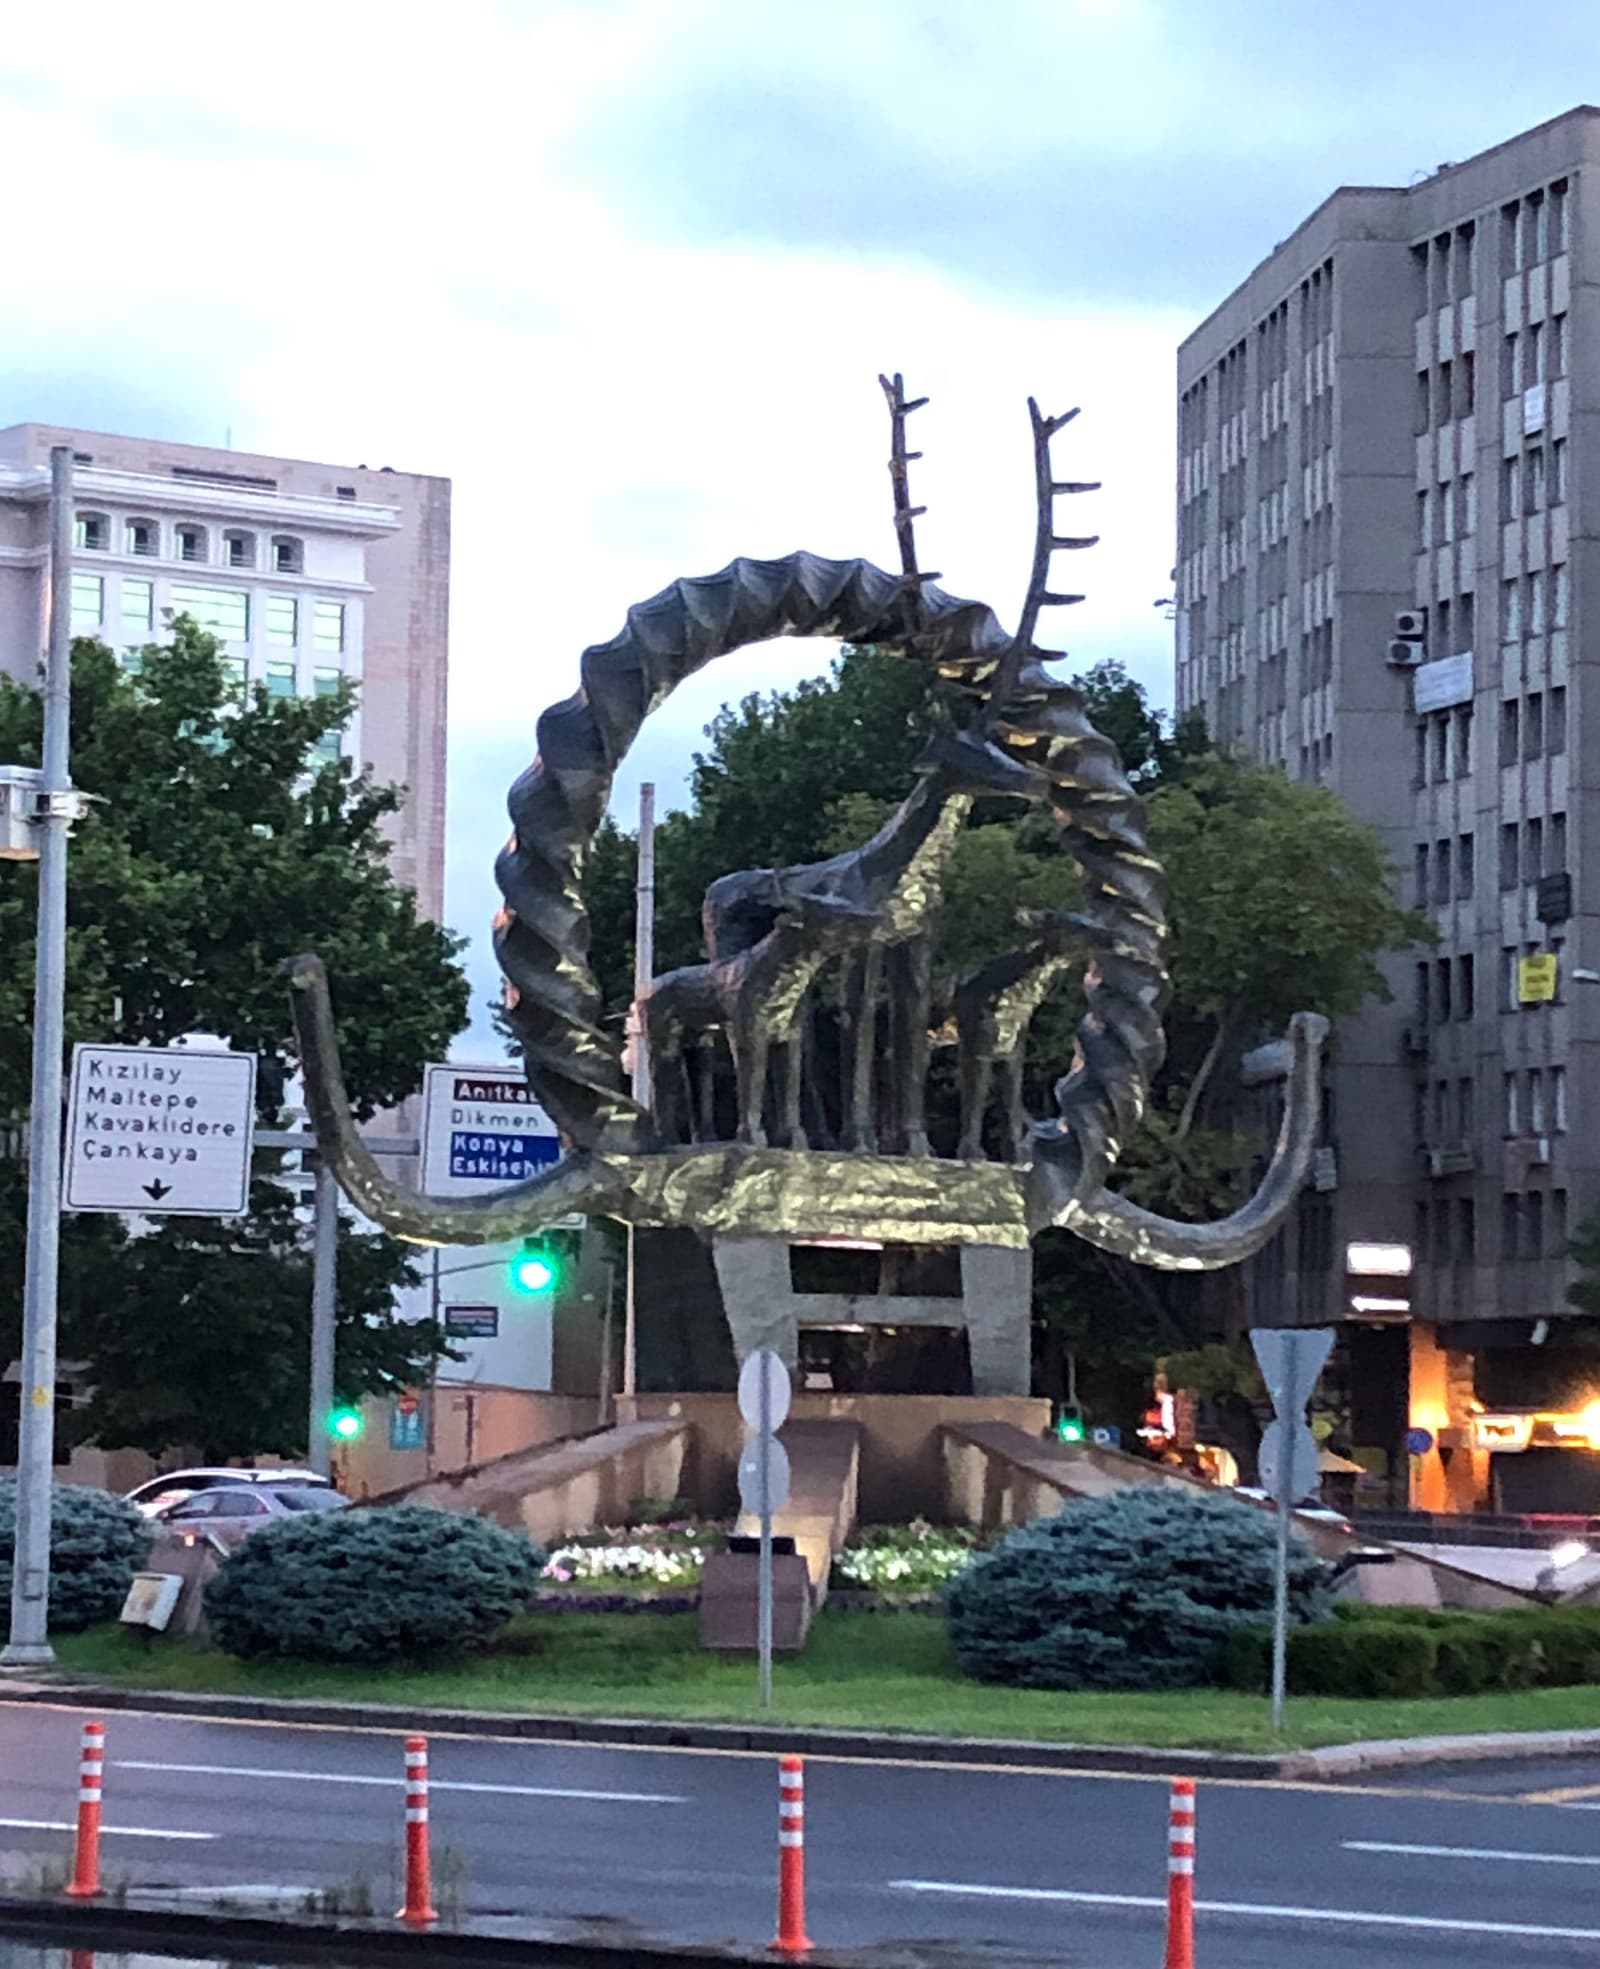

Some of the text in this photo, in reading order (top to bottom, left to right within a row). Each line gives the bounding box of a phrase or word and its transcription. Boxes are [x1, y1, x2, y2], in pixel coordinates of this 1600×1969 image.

[89, 1059, 182, 1085] Kızılay
[87, 1086, 198, 1111] Maltepe
[85, 1112, 236, 1136] Kavaklıdere
[451, 1108, 538, 1128] Dikmen
[83, 1139, 198, 1165] Çankaya
[453, 1135, 524, 1156] Konya
